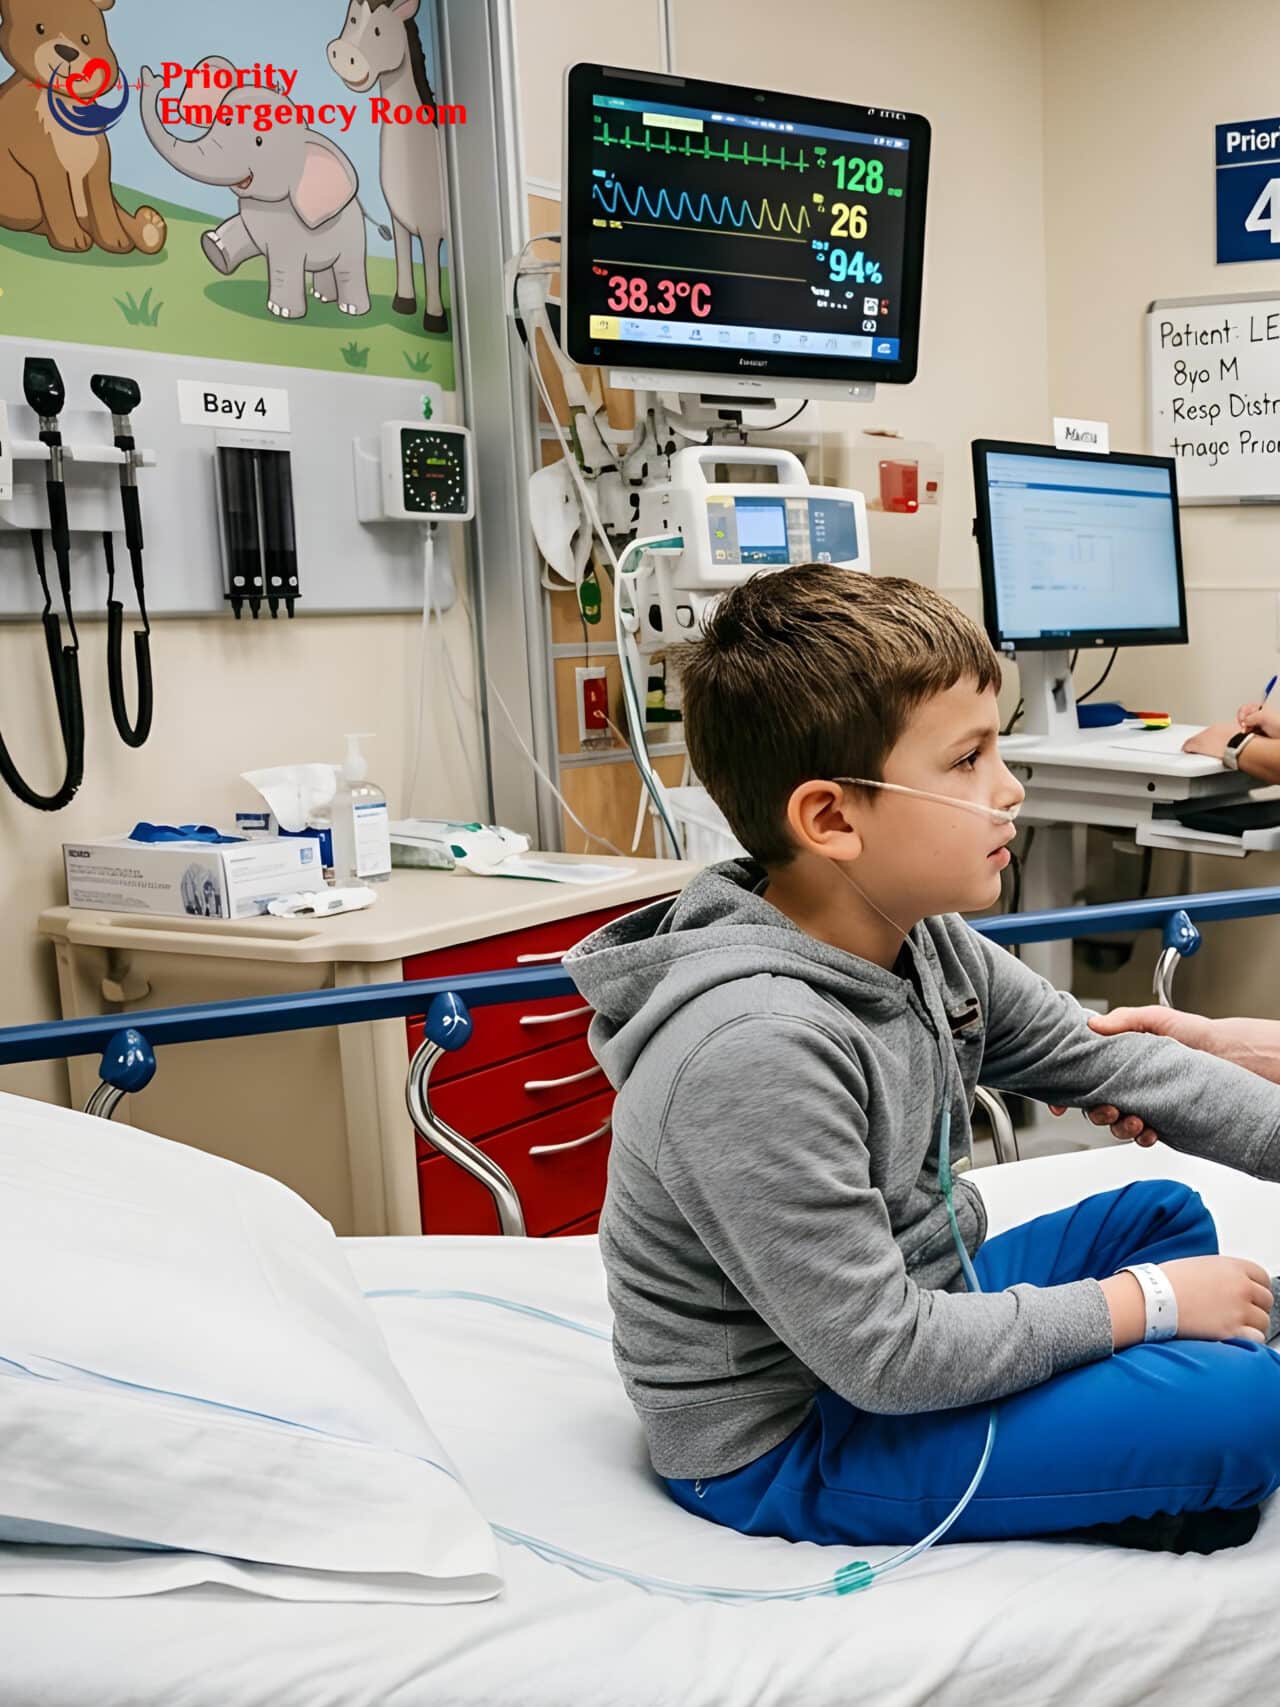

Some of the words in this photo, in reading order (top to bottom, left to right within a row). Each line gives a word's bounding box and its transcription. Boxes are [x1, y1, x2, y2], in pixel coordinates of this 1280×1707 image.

[831, 155, 884, 195] 128
[829, 202, 869, 240] 26
[607, 275, 712, 318] 38.3°C
[1173, 359, 1210, 393] 8yo
[1219, 356, 1240, 381] M
[203, 392, 247, 420] Bay
[253, 396, 268, 417] 4
[1172, 396, 1221, 426] Resp
